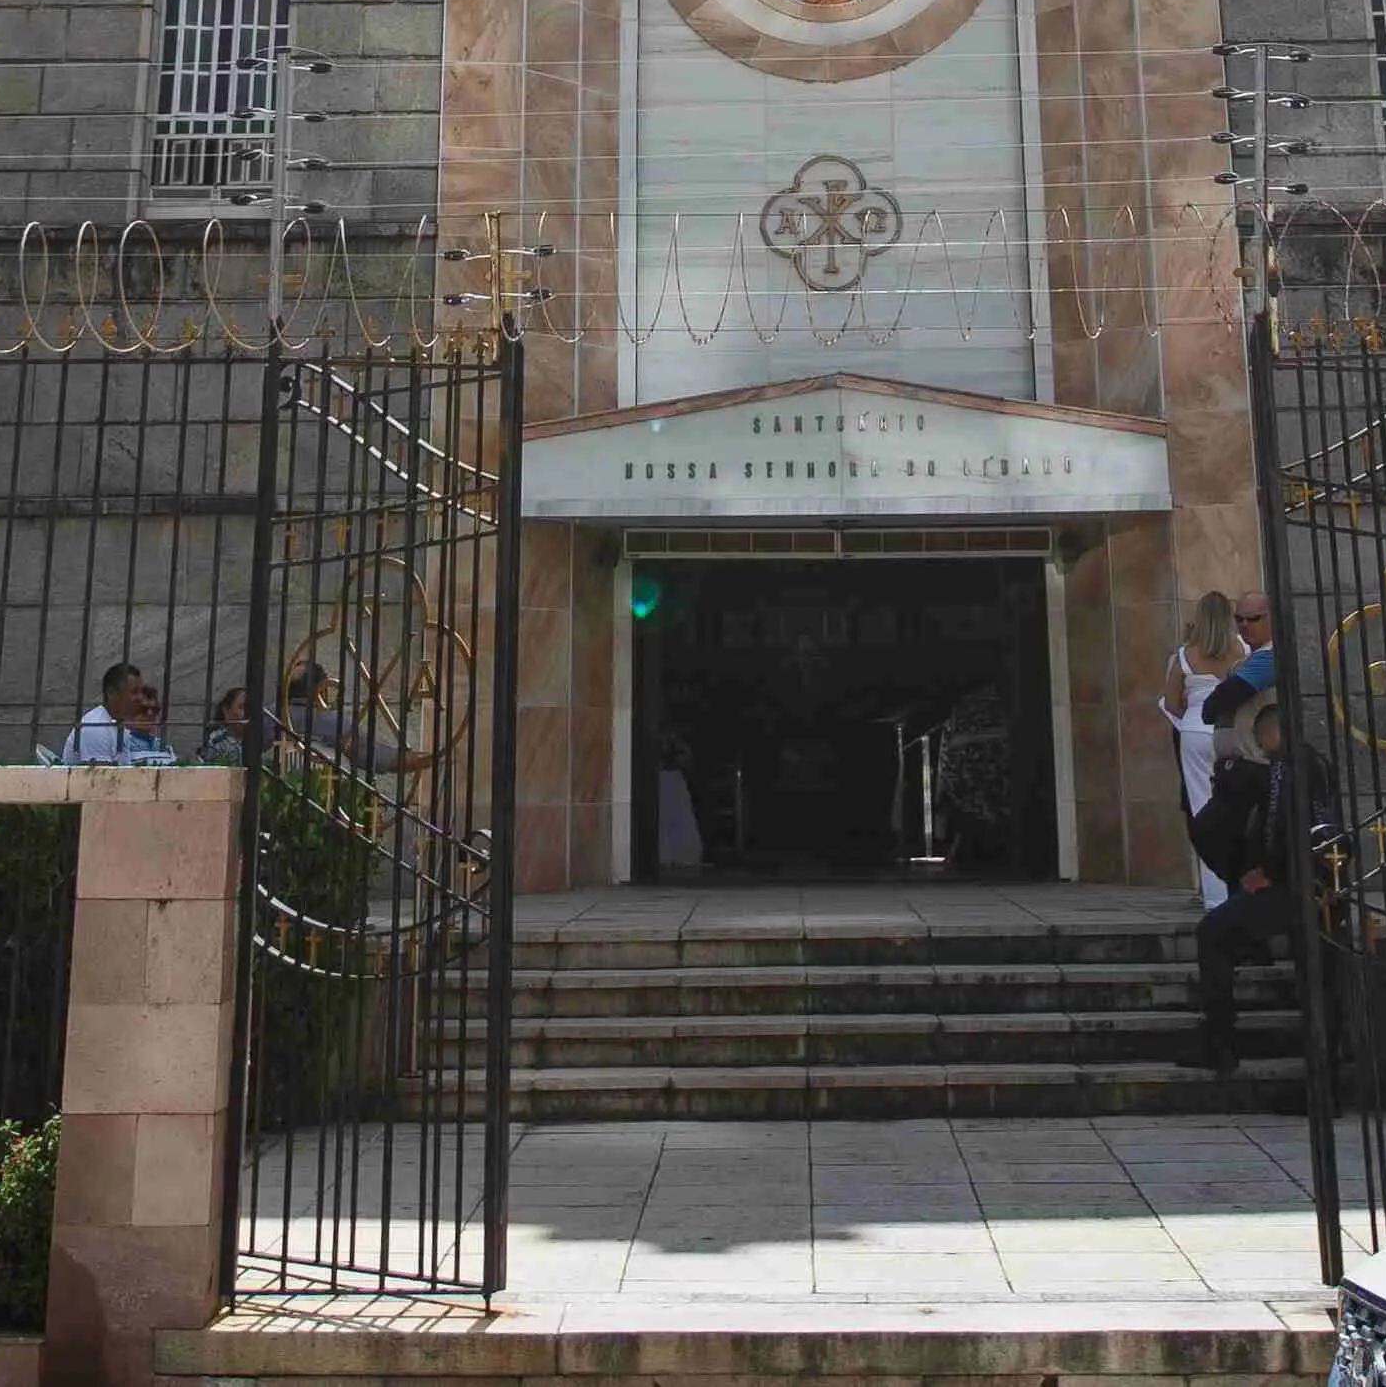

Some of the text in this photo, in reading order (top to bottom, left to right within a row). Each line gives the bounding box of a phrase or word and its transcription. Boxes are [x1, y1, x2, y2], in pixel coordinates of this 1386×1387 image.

[752, 411, 925, 434] SANTUÁRIO
[624, 461, 718, 480] NOSSA
[743, 459, 879, 479] SENHORA
[905, 459, 936, 477] DO
